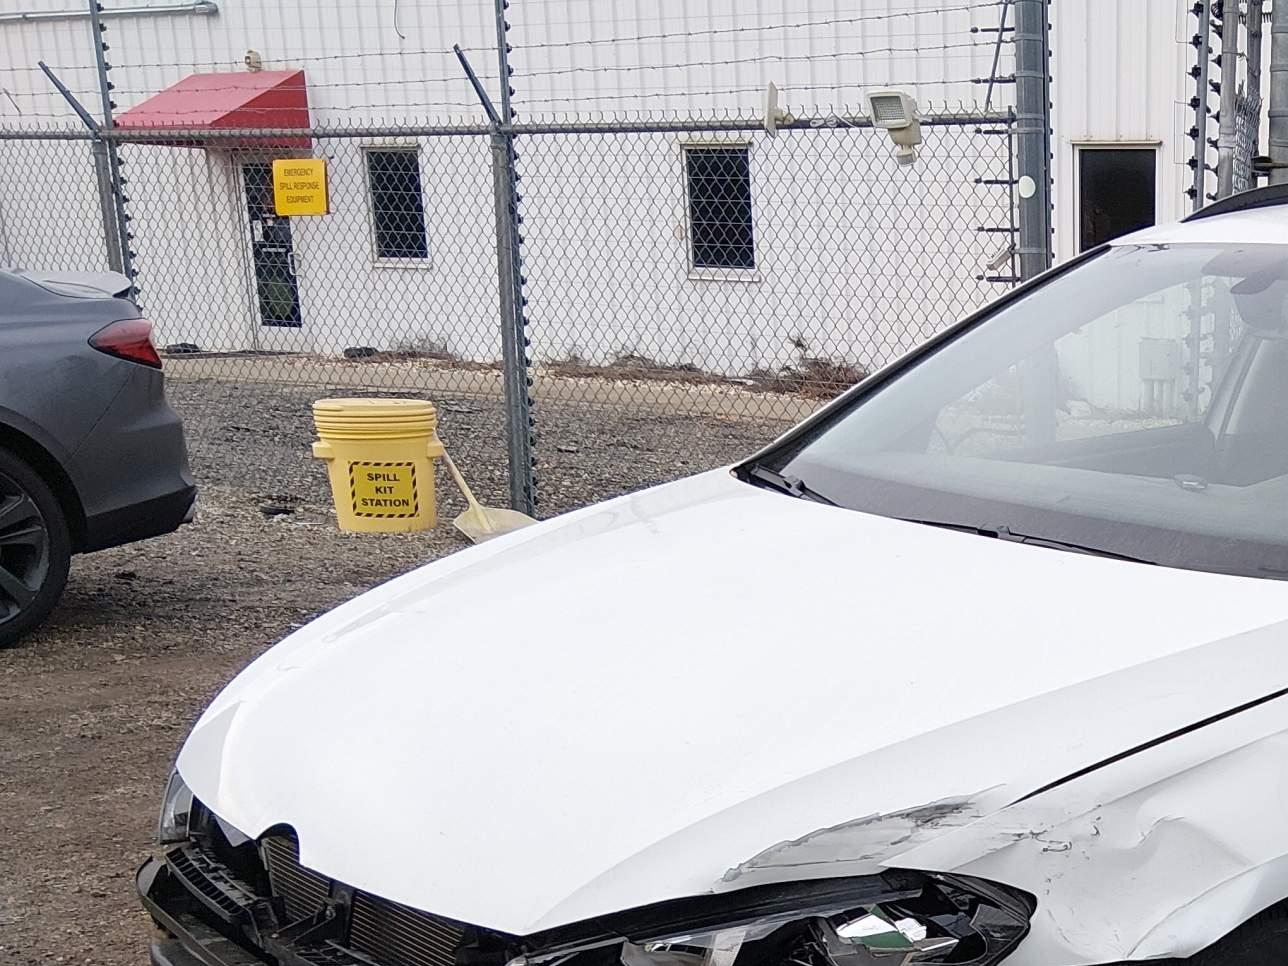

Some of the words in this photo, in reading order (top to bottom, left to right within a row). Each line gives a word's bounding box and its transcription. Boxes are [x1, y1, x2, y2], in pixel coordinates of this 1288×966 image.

[283, 168, 313, 177] EMERGENCY
[279, 182, 292, 190] SPILL
[293, 181, 320, 190] RESPONSE
[286, 195, 314, 204] EQUIPMENT
[367, 473, 400, 481] SPILL
[375, 486, 394, 495] KIT
[361, 498, 410, 507] STATION
